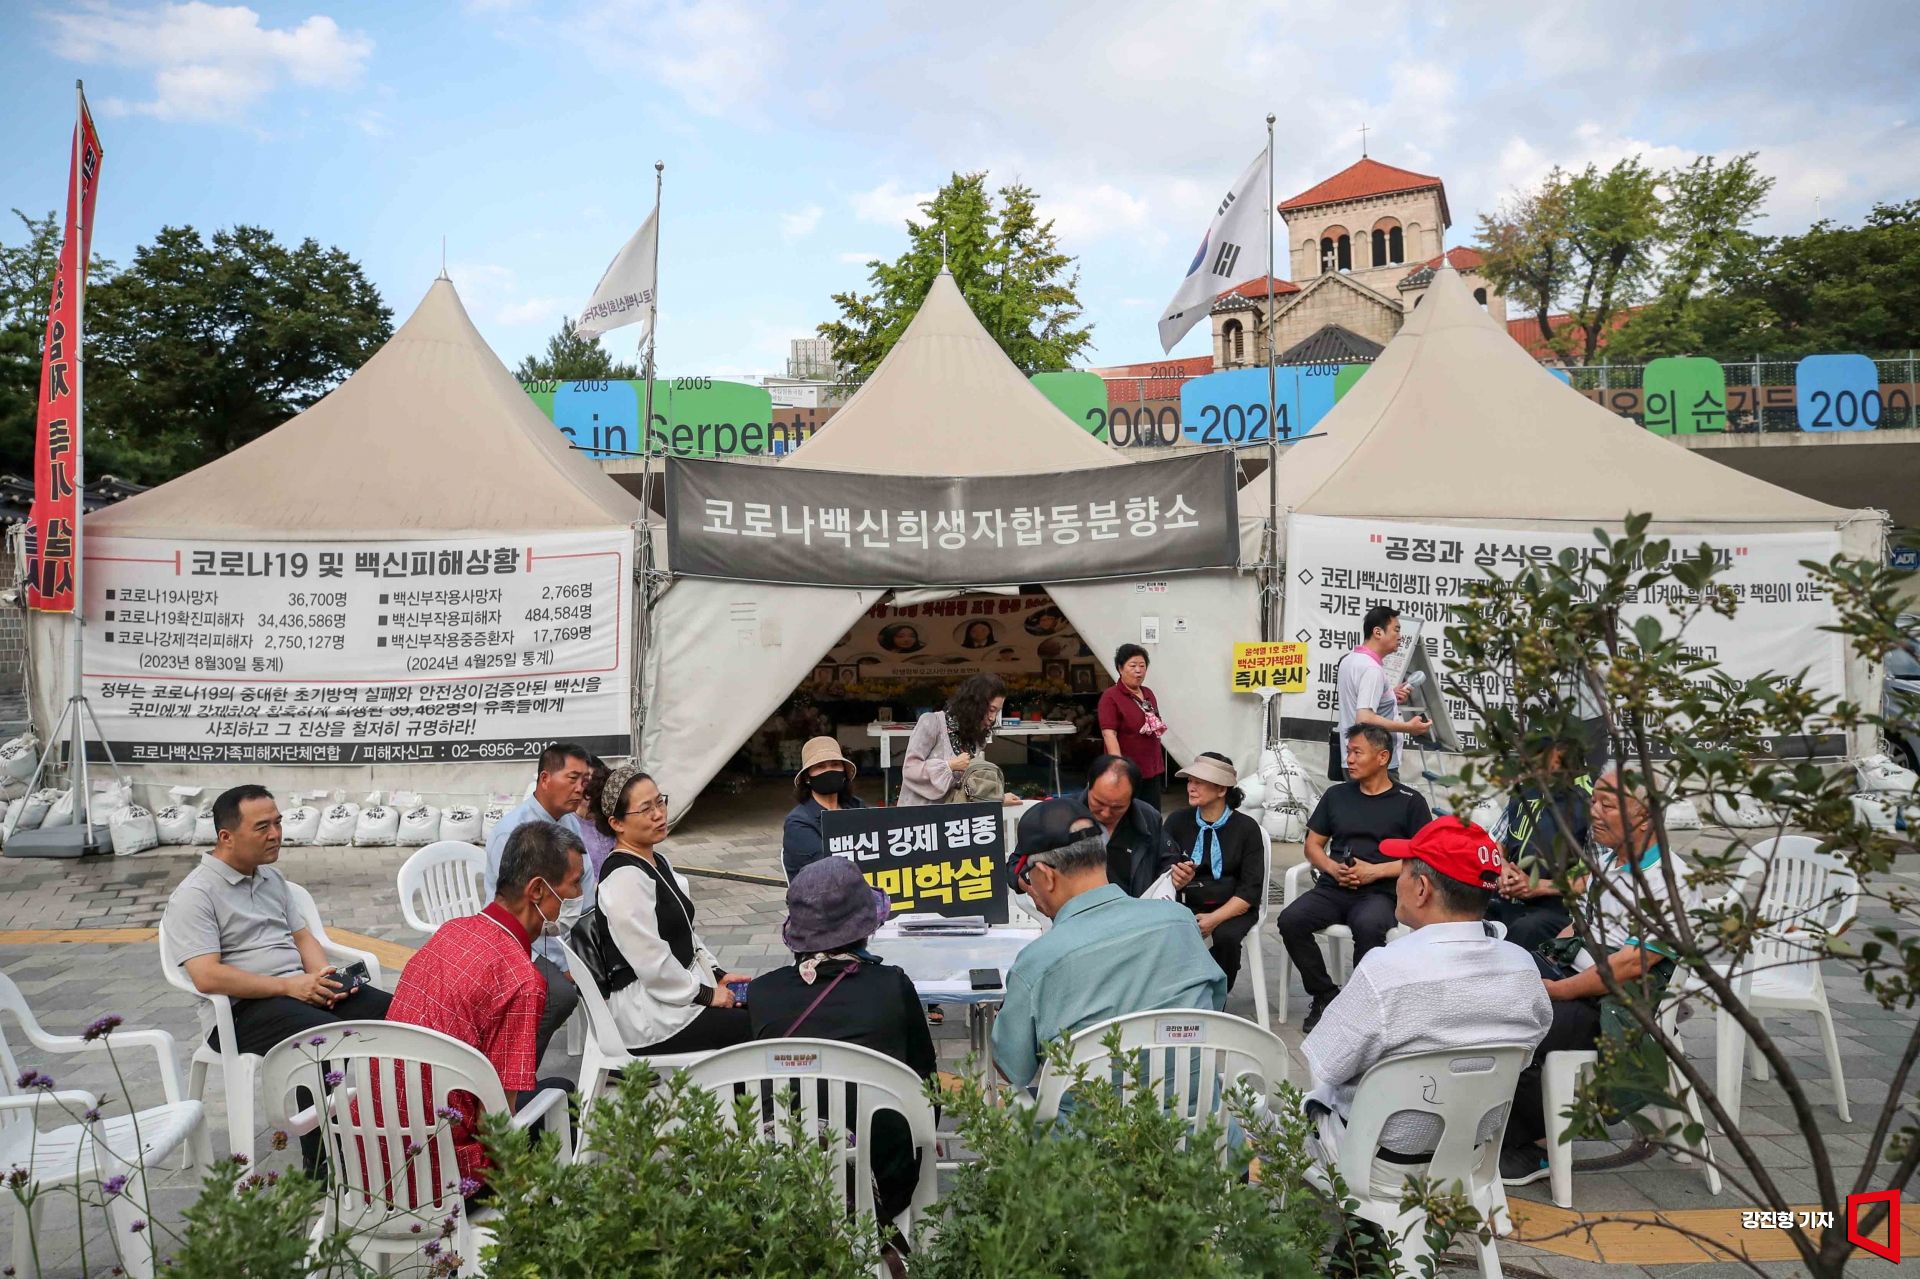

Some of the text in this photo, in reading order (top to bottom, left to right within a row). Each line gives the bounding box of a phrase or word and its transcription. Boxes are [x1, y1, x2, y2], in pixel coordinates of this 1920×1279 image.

[1150, 366, 1185, 380] 2008
[1305, 364, 1340, 377] 2009
[523, 380, 557, 394] 2002
[573, 379, 609, 392] 2003
[676, 376, 712, 390] 2005
[1810, 390, 1910, 427] 2000
[592, 402, 1292, 459] in Serpenti 2000-2024
[702, 493, 1199, 550] 코로나백신희생자합동분향소
[191, 547, 520, 578] 코로나19 및 백신피해상황
[1474, 542, 1553, 569] 상식은
[1895, 552, 1917, 565] ADT
[393, 582, 593, 606] 백신부작용사망자 2,766명
[1321, 567, 1431, 597] 코로나백신희생자
[1750, 583, 1791, 603] 책임이
[119, 588, 347, 608] 코로나19사망자 36,700명
[1320, 593, 1361, 616] 국가로
[118, 609, 346, 629] 코로나19확진피해자 34,436,586명
[392, 604, 592, 628] 백신부작용피해자 484,584명
[117, 631, 345, 650] 코로나강제격리피해자 2,750,127명
[391, 625, 592, 649] 백신부작용중증환자 17,769명
[139, 653, 284, 673] (2023년 8월30일 통계)
[406, 649, 554, 673] (2024년 4월25일 통계)
[1237, 654, 1303, 669] 백신국가책임제
[1235, 669, 1267, 688] 즉시
[1271, 666, 1303, 686] 실시
[100, 676, 602, 703] 정부는 코로나19의 중대한 초기방역 실패와 안전성이검증안된 백신을
[128, 702, 190, 718] 국민에게
[484, 697, 565, 715] 유족들에게
[205, 719, 477, 738] 사죄하고 그 진상을 철저히 규명하라!
[131, 745, 341, 762] 코로나백신유가족피해자단체연합
[363, 744, 434, 761] 피해자신고
[829, 814, 997, 862] 백신 강제 접종
[862, 855, 995, 911] 민학살
